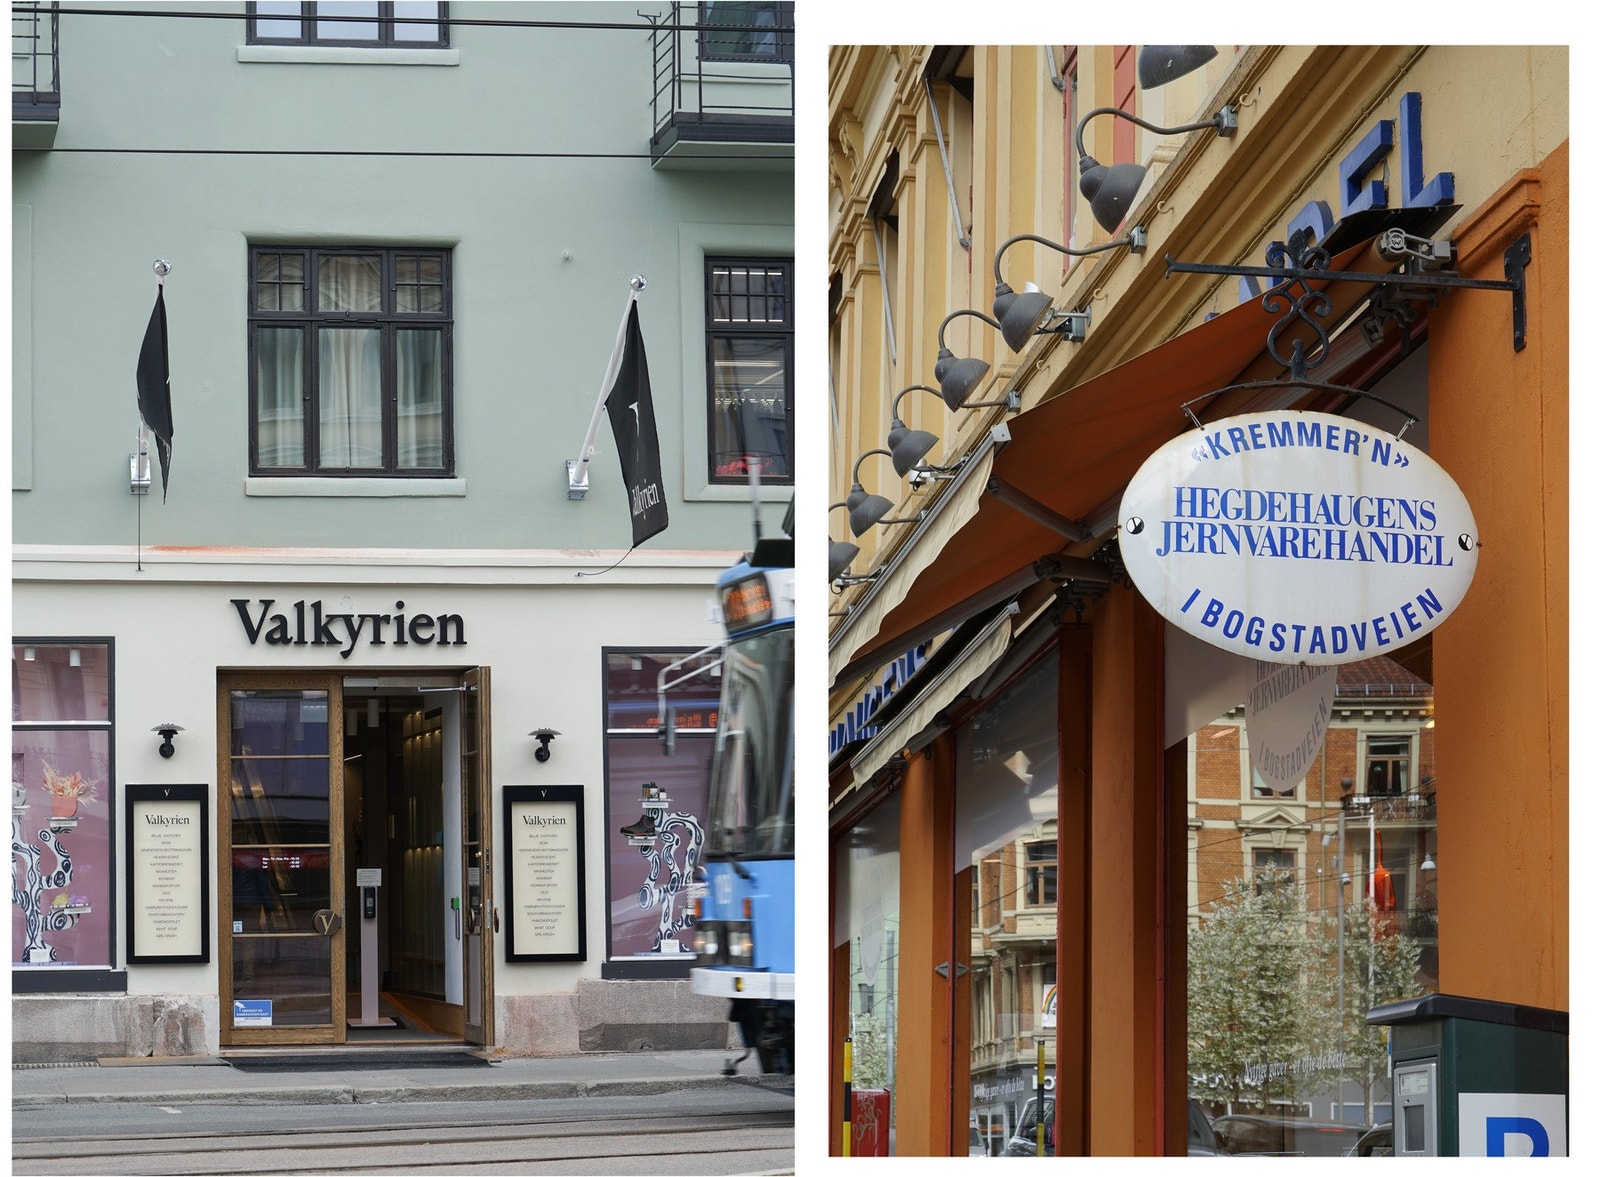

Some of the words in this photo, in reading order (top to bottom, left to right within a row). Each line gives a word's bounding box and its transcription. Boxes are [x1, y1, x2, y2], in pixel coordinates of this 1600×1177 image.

[1173, 486, 1437, 532] HEGDEHAUGENS
[1156, 520, 1454, 567] JERNVAREHANDEL
[230, 599, 468, 660] Valkyrien
[1180, 588, 1201, 614] I
[1200, 587, 1444, 655] BOGSTADVEIEN
[145, 814, 190, 828] Valkyrien
[522, 815, 567, 828] Valkyrien
